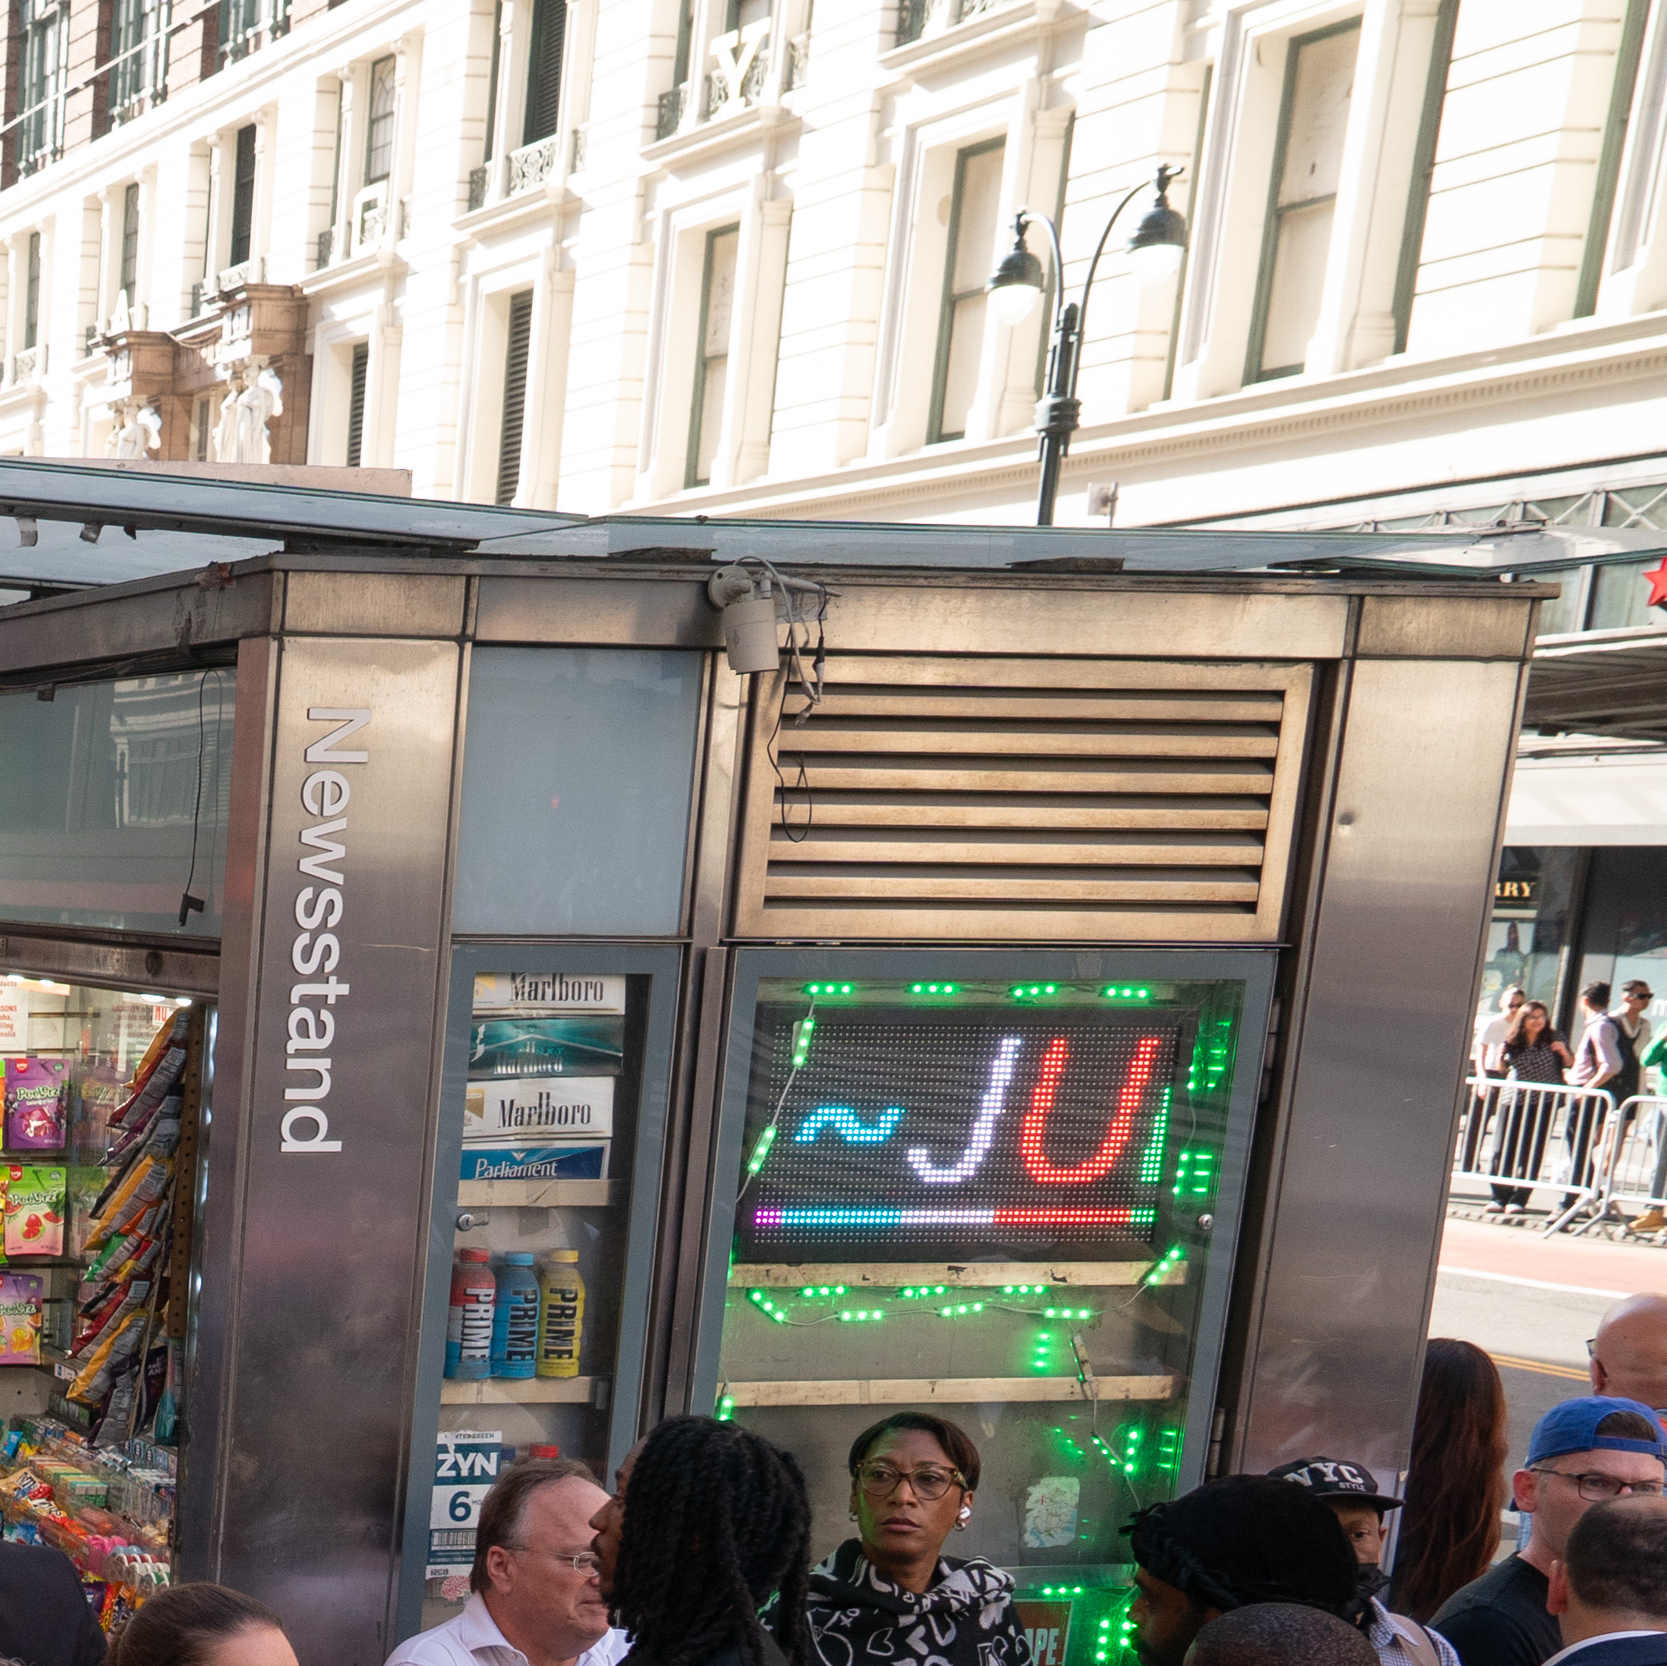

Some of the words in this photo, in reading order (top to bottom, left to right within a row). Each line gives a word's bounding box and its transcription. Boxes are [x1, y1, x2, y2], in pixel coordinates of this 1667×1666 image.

[280, 706, 371, 1154] Newsstand
[509, 972, 604, 1003] Marlboro
[497, 1092, 591, 1129] Marlboro
[474, 1158, 558, 1180] Parliament
[462, 1287, 497, 1362] PRIME
[506, 1287, 539, 1361] PRIME
[543, 1287, 579, 1360] PRIME
[436, 1452, 499, 1478] ZYN
[1283, 1461, 1365, 1487] NYC
[447, 1489, 473, 1522] 6
